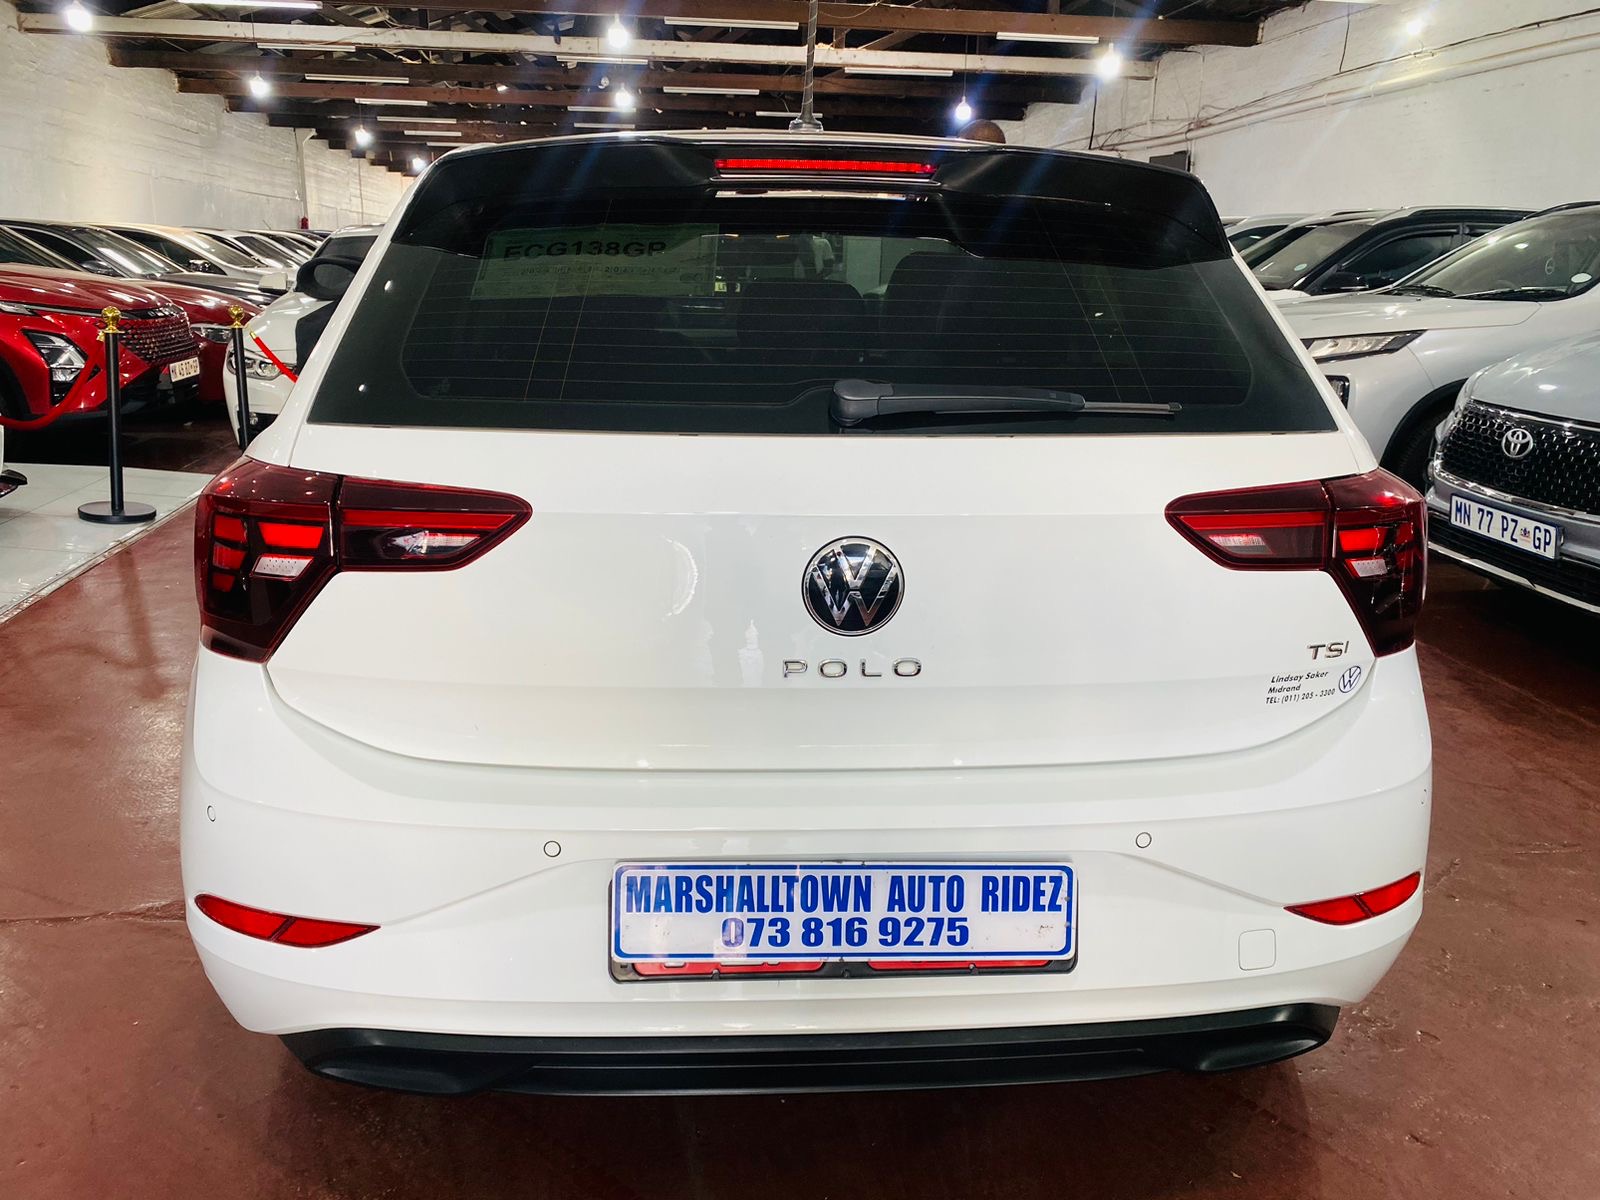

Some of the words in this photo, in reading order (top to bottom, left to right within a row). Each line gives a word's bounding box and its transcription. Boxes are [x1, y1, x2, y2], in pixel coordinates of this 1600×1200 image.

[1455, 500, 1471, 527] MN
[1477, 508, 1494, 534] 77
[1501, 515, 1518, 543] PZ
[1532, 525, 1552, 553] GP
[783, 658, 922, 678] POLO
[1270, 674, 1303, 684] Lindsay
[1305, 671, 1329, 681] Saker
[1265, 696, 1280, 704] TEL:
[1281, 694, 1299, 704] (011)
[1268, 684, 1301, 694] Midrand
[625, 874, 872, 914] MARSHALLTOWN
[888, 874, 964, 913] AUTO
[980, 874, 1064, 913] RIDEZ
[721, 917, 790, 948] 073
[801, 917, 868, 948] 816
[878, 916, 969, 947] 9275
